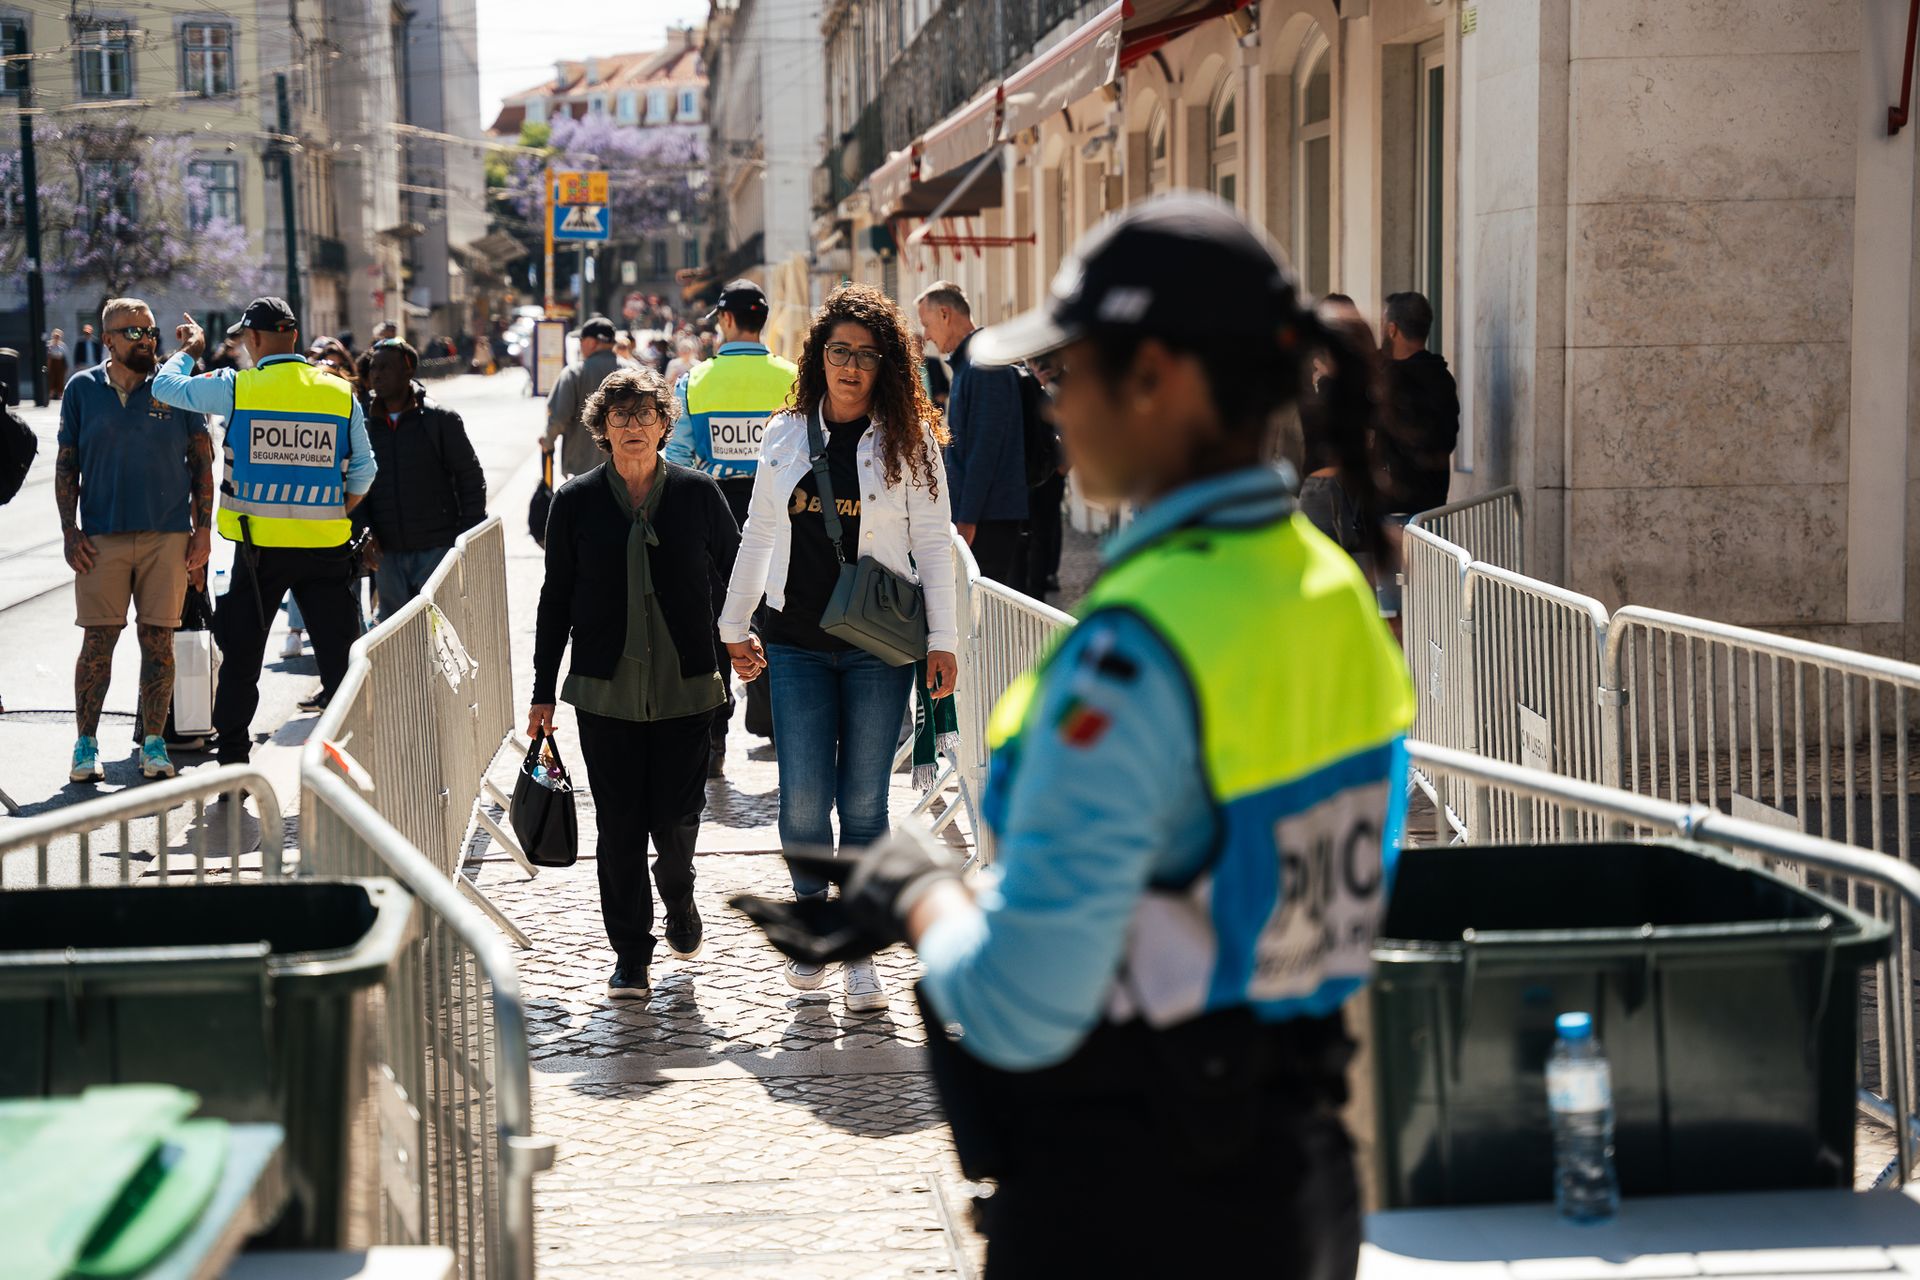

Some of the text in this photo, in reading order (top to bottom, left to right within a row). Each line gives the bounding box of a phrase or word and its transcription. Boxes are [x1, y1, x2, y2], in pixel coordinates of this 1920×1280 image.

[253, 425, 332, 450] POLÍCIA
[711, 420, 763, 443] POLÍC
[253, 451, 331, 462] SEGURANÇA PÚBLICA
